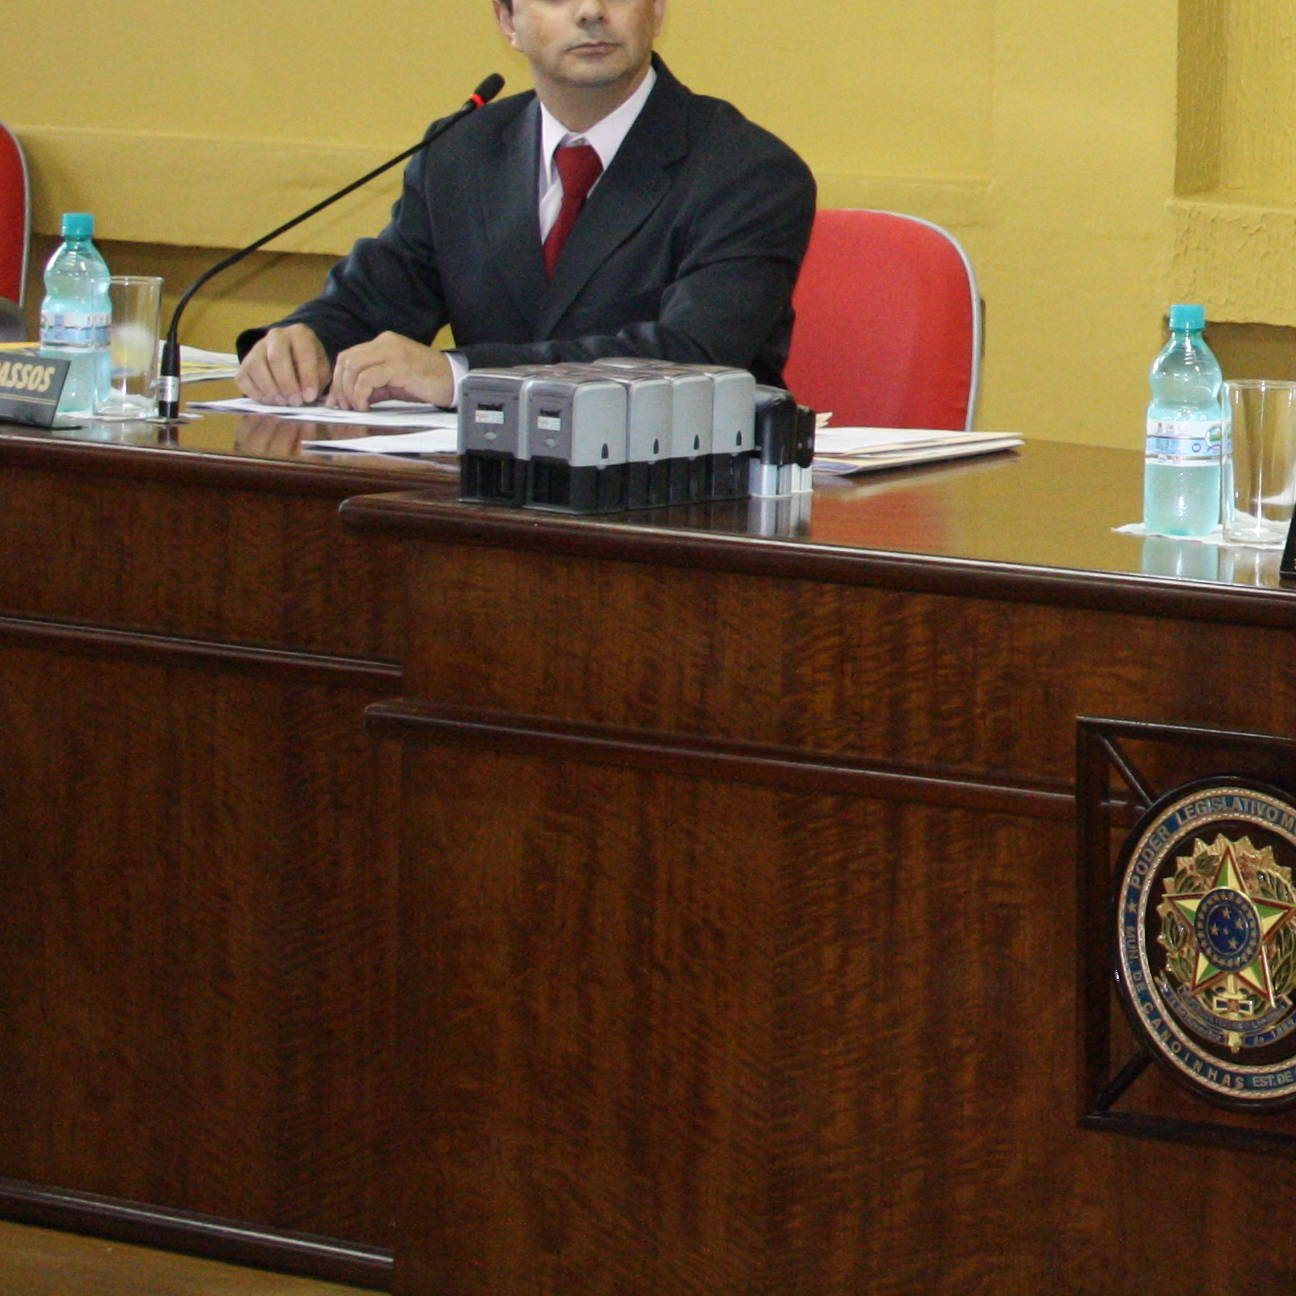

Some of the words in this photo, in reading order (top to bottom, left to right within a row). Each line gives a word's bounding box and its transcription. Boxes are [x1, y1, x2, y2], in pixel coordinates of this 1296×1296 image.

[0, 360, 56, 393] ASSOS
[1130, 825, 1171, 889] PODER
[1175, 796, 1279, 827] LEGISLATIVO
